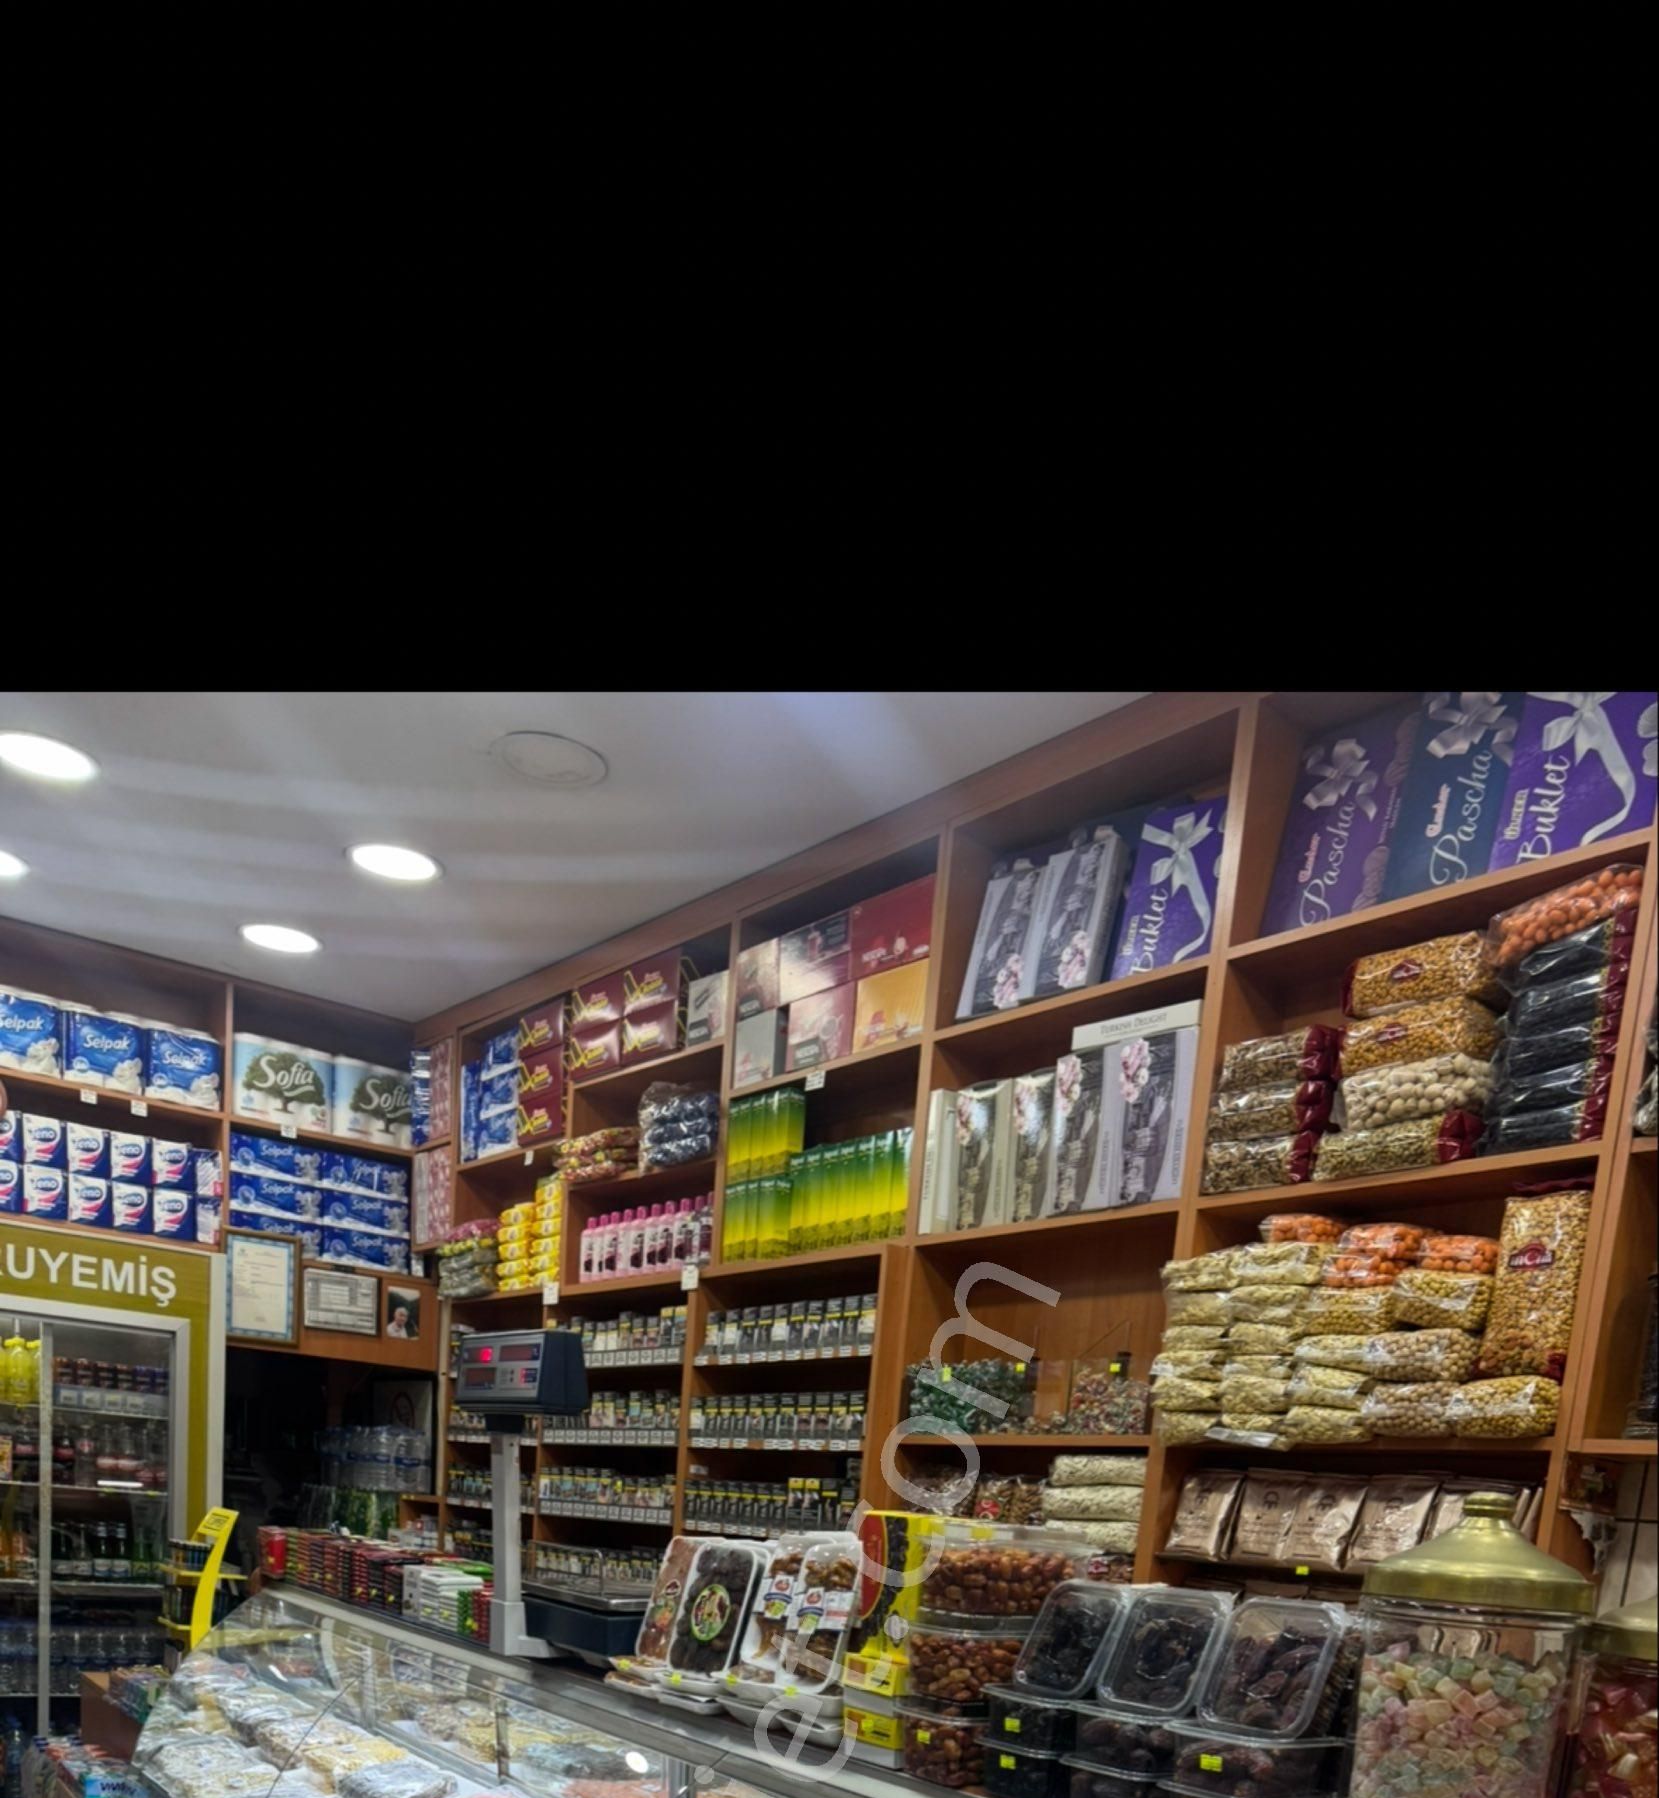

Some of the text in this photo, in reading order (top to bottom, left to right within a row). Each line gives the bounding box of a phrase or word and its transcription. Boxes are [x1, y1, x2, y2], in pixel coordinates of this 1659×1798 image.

[1430, 749, 1493, 885] Pascha
[1517, 754, 1571, 864] Buklet
[1301, 800, 1356, 927] Pascha
[1131, 887, 1169, 975] Buklet
[83, 1034, 131, 1051] Selpak
[253, 1055, 315, 1090] Sofia
[0, 1243, 178, 1308] UYEMİŞ
